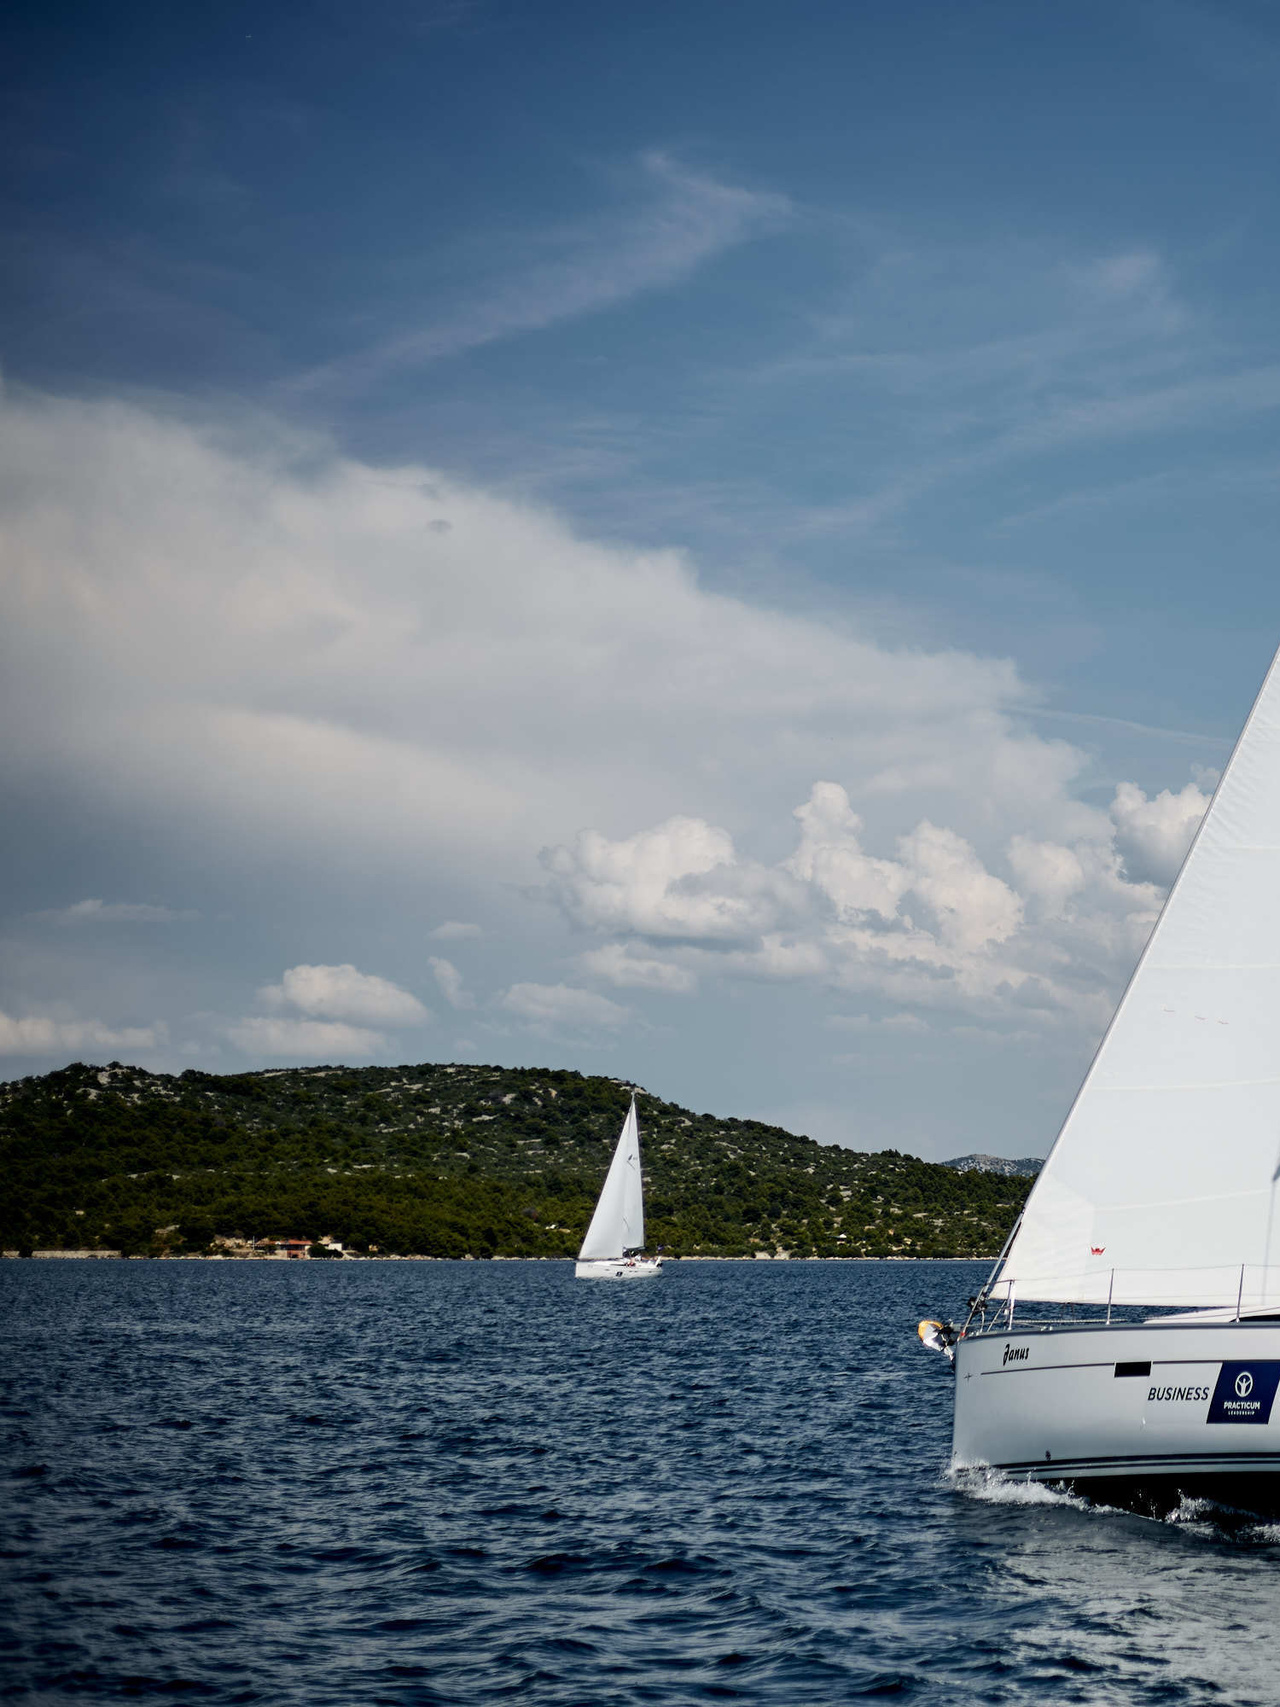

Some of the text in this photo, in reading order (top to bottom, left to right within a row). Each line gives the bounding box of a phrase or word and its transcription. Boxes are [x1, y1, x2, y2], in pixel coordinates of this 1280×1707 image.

[1003, 1343, 1029, 1366] Janus
[1147, 1387, 1210, 1401] BUSINESS
[1223, 1401, 1260, 1410] PRACTICUM
